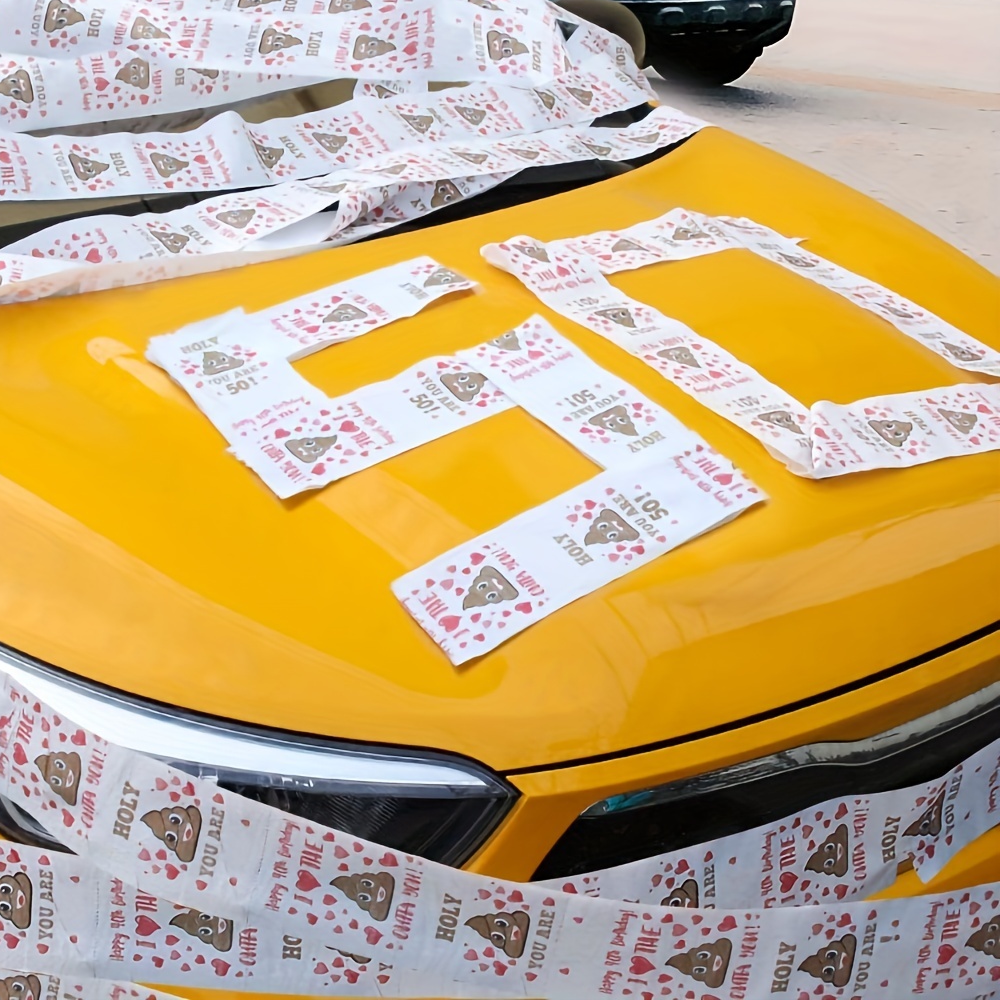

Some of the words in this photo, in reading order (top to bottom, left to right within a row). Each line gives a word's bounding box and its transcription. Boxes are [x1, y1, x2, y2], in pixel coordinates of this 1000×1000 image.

[86, 8, 106, 38] HOLY
[305, 31, 323, 57] HOLY
[90, 55, 106, 75] THE
[278, 135, 306, 159] HOLY
[0, 166, 16, 186] THE
[109, 152, 132, 177] HOLY
[180, 224, 213, 246] HOLY
[225, 377, 258, 395] 50!
[421, 377, 443, 396] YOU
[437, 396, 462, 412] ARE
[564, 389, 597, 407] 50!
[409, 393, 441, 414] 50!
[570, 404, 595, 419] ARE
[595, 394, 620, 409] YOU
[626, 430, 666, 453] HOLY
[612, 493, 640, 517] ARE
[634, 491, 670, 520] 50!
[634, 517, 660, 538] YOU
[552, 533, 595, 566] HOLY
[418, 591, 449, 620] THE
[16, 709, 35, 744] THE
[113, 780, 141, 840] HOLY
[208, 806, 225, 842] ARE
[300, 838, 323, 869] THE
[780, 834, 796, 871] THE
[881, 815, 901, 864] HOLY
[199, 843, 218, 877] YOU
[39, 869, 54, 903] ARE
[704, 864, 716, 898] ARE
[38, 906, 54, 940] YOU
[435, 893, 462, 943] HOLY
[536, 909, 555, 940] ARE
[941, 908, 961, 942] THE
[634, 925, 661, 954] THE
[861, 923, 878, 956] ARE
[528, 941, 547, 969] YOU
[771, 941, 797, 993] HOLY
[854, 962, 871, 993] YOU
